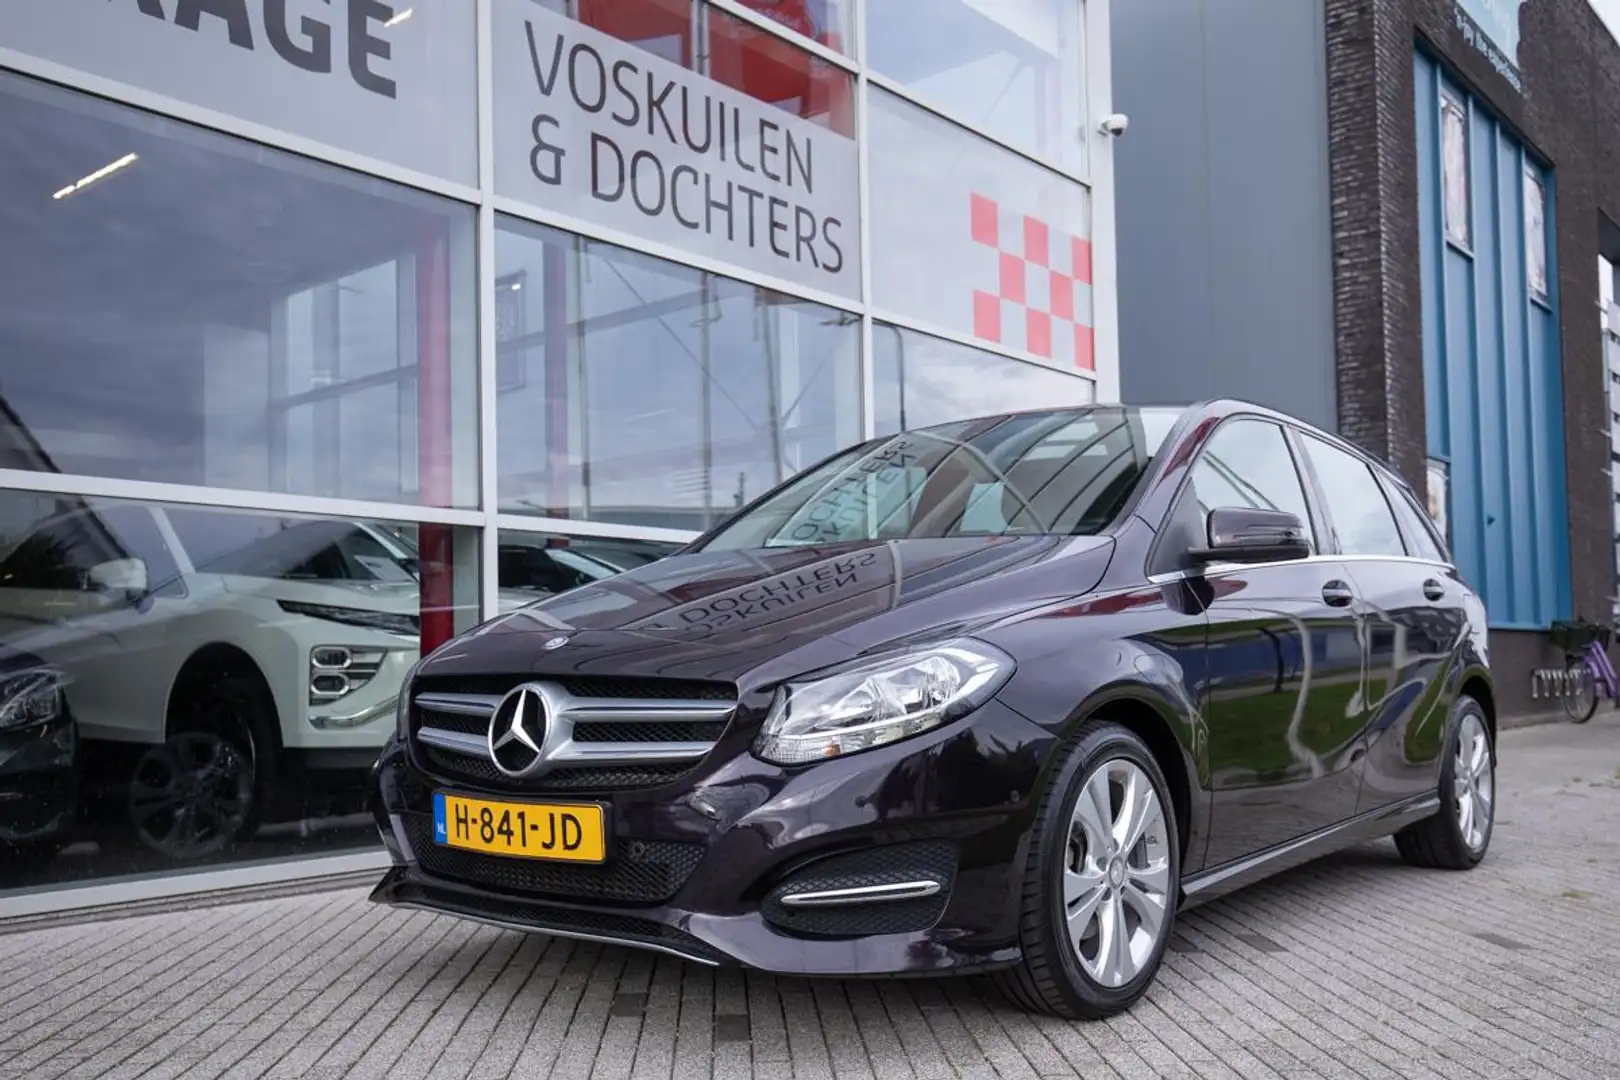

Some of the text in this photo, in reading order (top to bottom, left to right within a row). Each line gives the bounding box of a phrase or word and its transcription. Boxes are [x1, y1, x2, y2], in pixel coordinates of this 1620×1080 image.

[525, 20, 812, 194] VOSKUILEN
[530, 114, 843, 273] & DOCHTERS
[455, 803, 582, 850] H-841-JD
